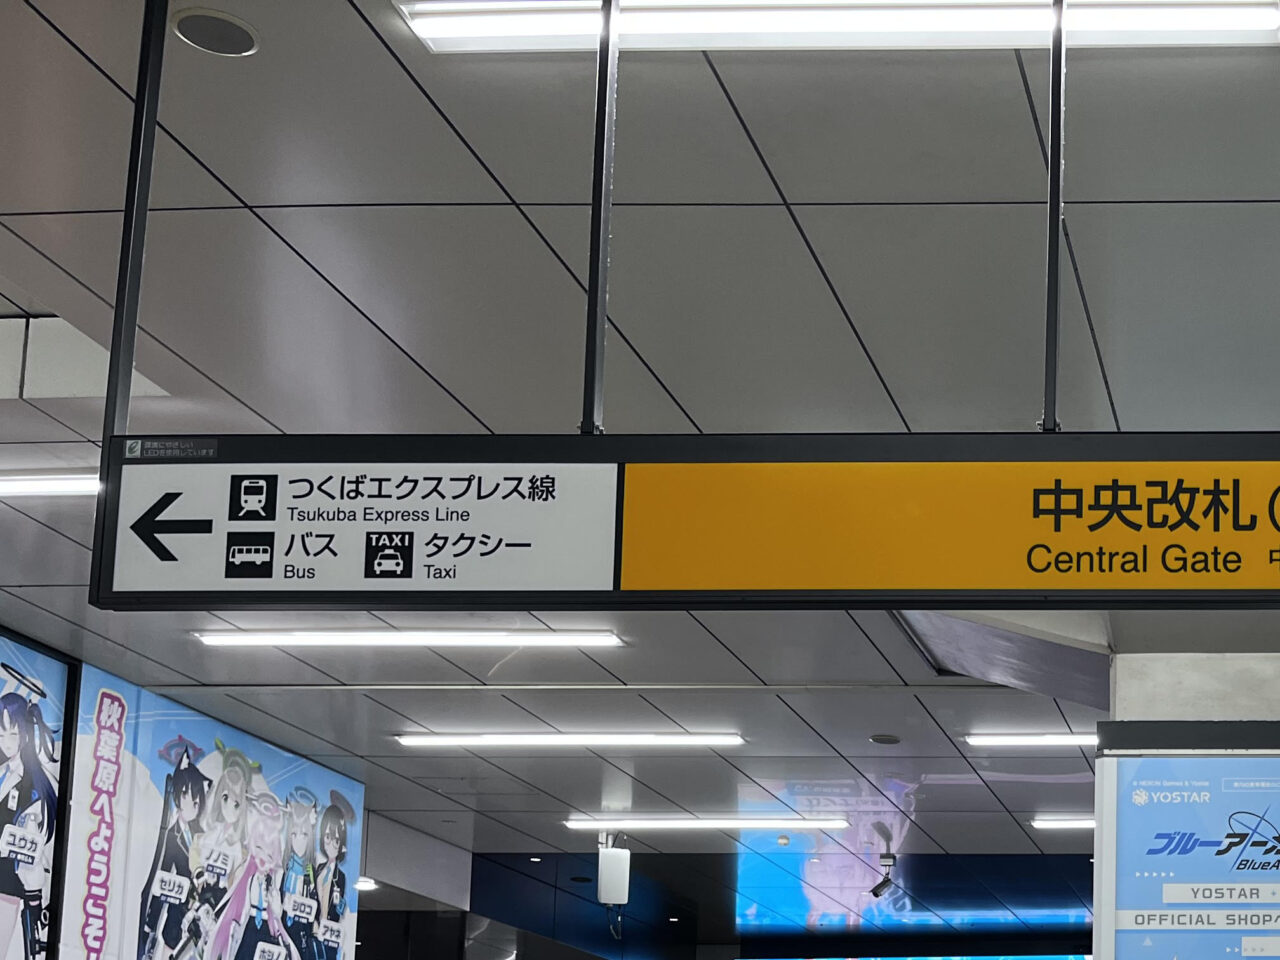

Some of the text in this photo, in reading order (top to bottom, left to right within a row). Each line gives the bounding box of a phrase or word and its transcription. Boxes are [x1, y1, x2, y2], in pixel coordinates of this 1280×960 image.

[288, 475, 556, 502] つくばエクスプレス線
[287, 507, 470, 524] Tsukuba Express Line
[284, 532, 338, 558] バス
[369, 534, 410, 547] TAXI
[424, 532, 532, 558] タクシー
[1027, 544, 1243, 574] Central Gate
[284, 564, 316, 580] Bus
[424, 564, 457, 580] Taxi
[1151, 791, 1211, 803] YOSTAR
[7, 833, 38, 852] ユウカ
[206, 850, 230, 865] ノノミ
[159, 878, 184, 894] セリカ
[1191, 887, 1261, 900] YOSTAR
[292, 902, 313, 914] シロコ
[1134, 914, 1216, 926] OFFICIAL
[321, 924, 342, 939] アヤネ
